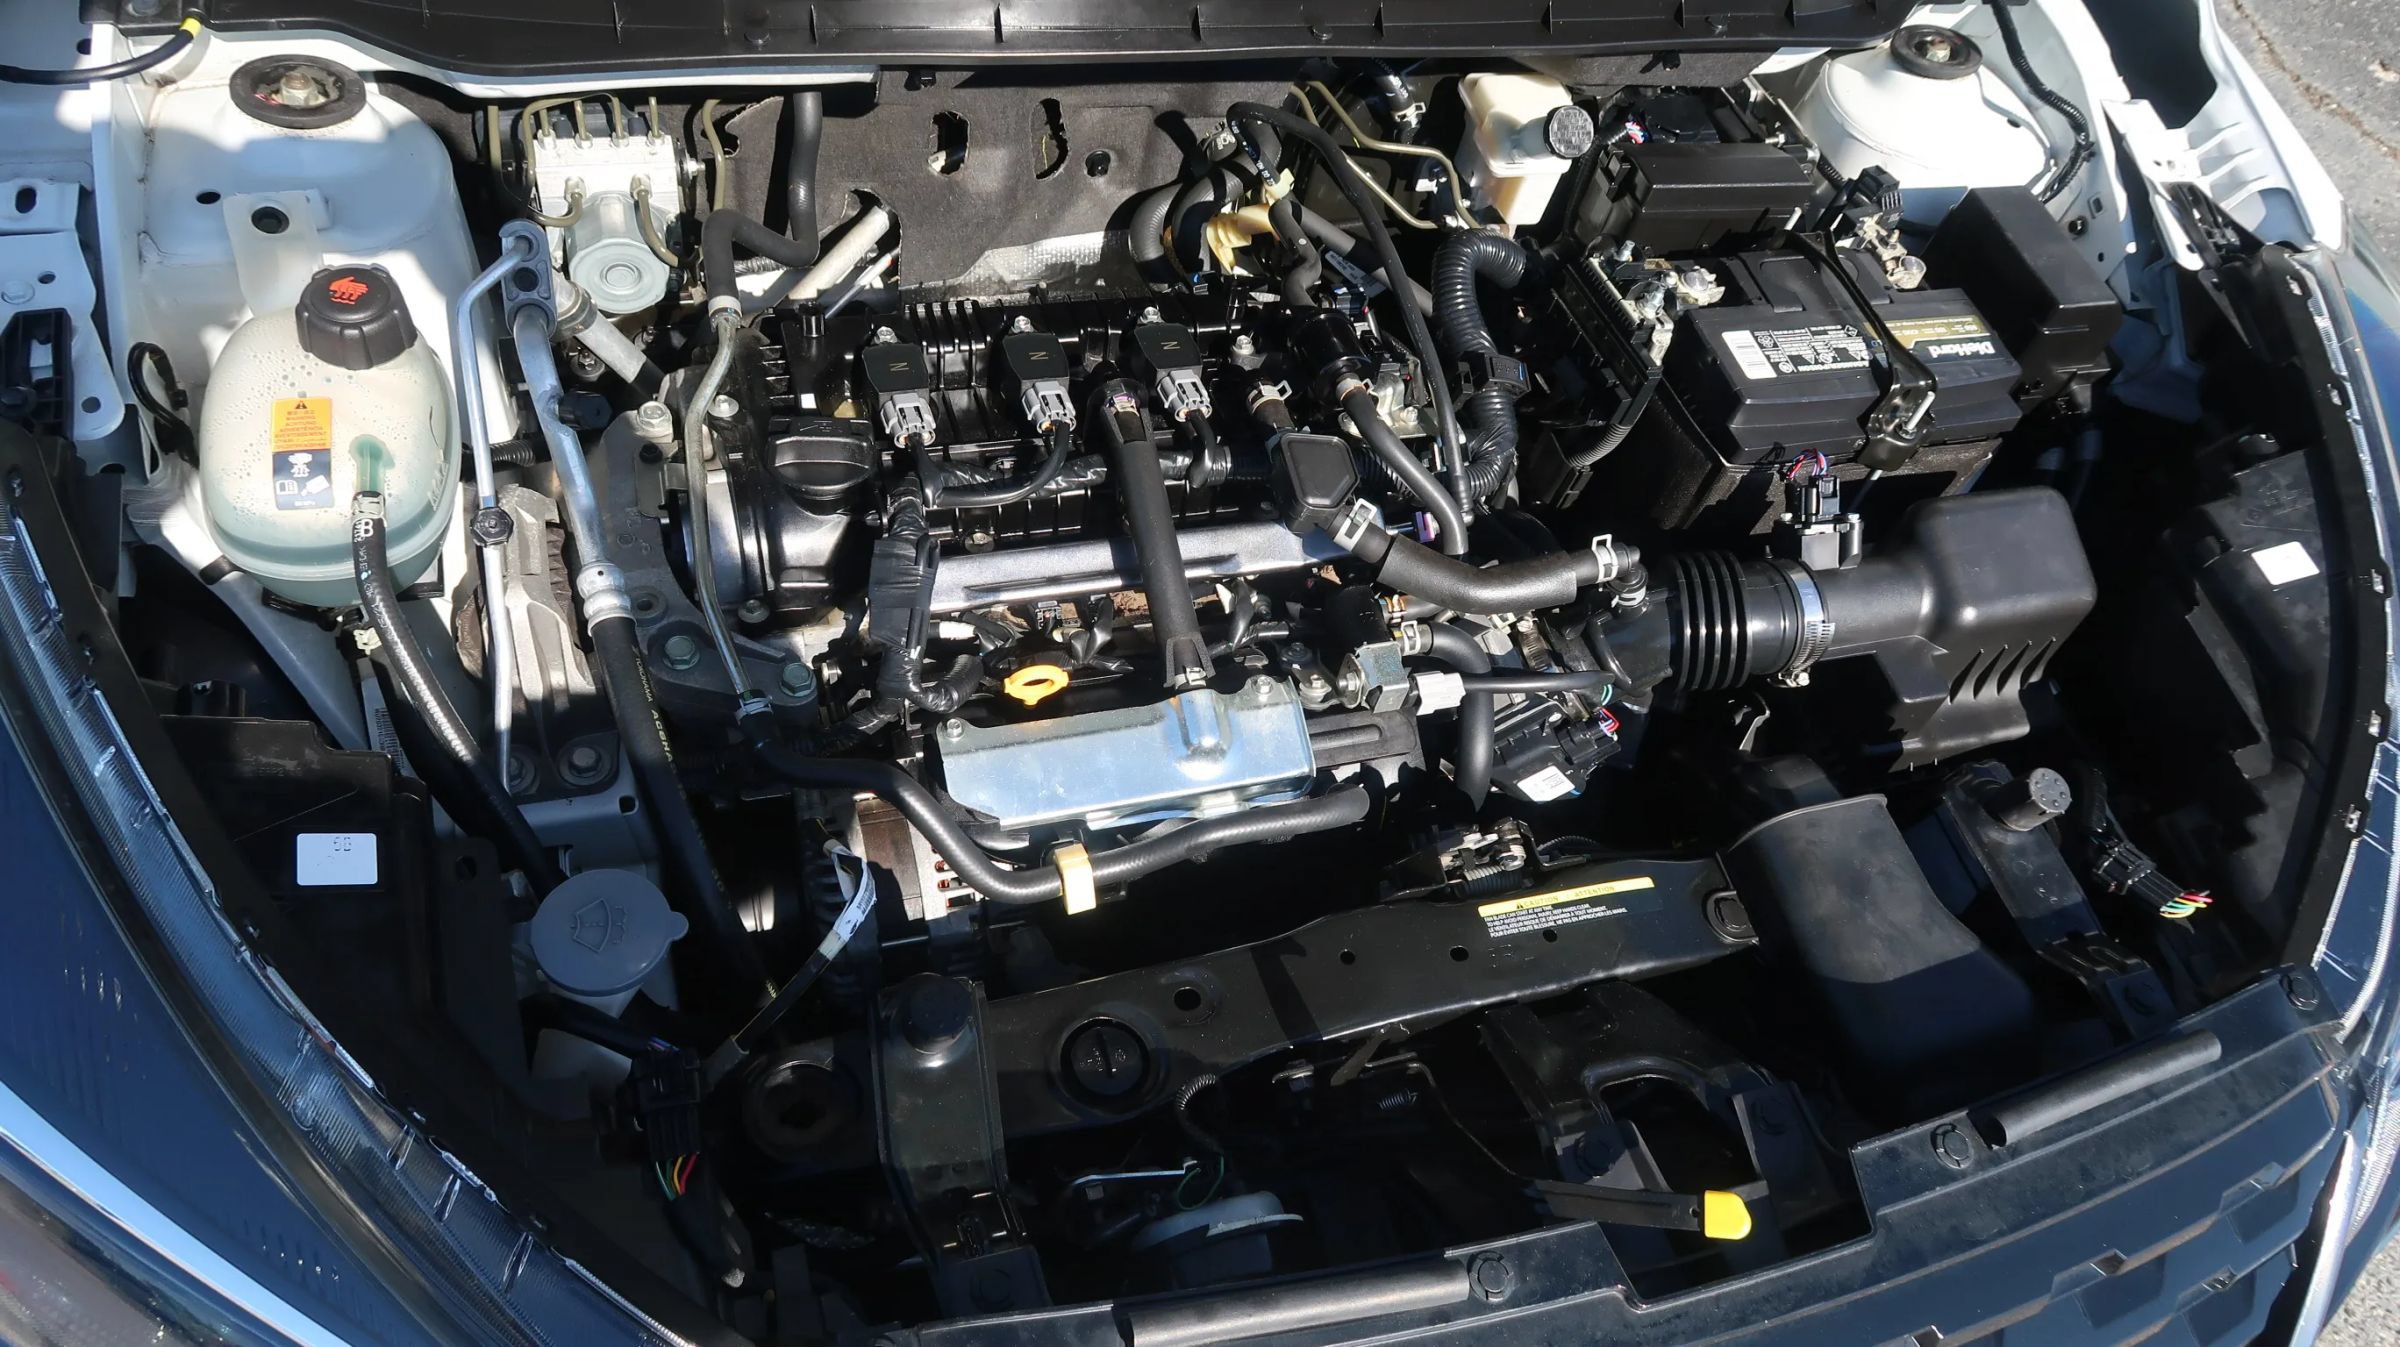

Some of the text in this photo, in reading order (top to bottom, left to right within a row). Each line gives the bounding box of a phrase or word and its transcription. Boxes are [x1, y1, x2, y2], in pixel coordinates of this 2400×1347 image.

[1929, 340, 1995, 358] DieHard
[1523, 886, 1614, 907] CAUTION ATTENTION
